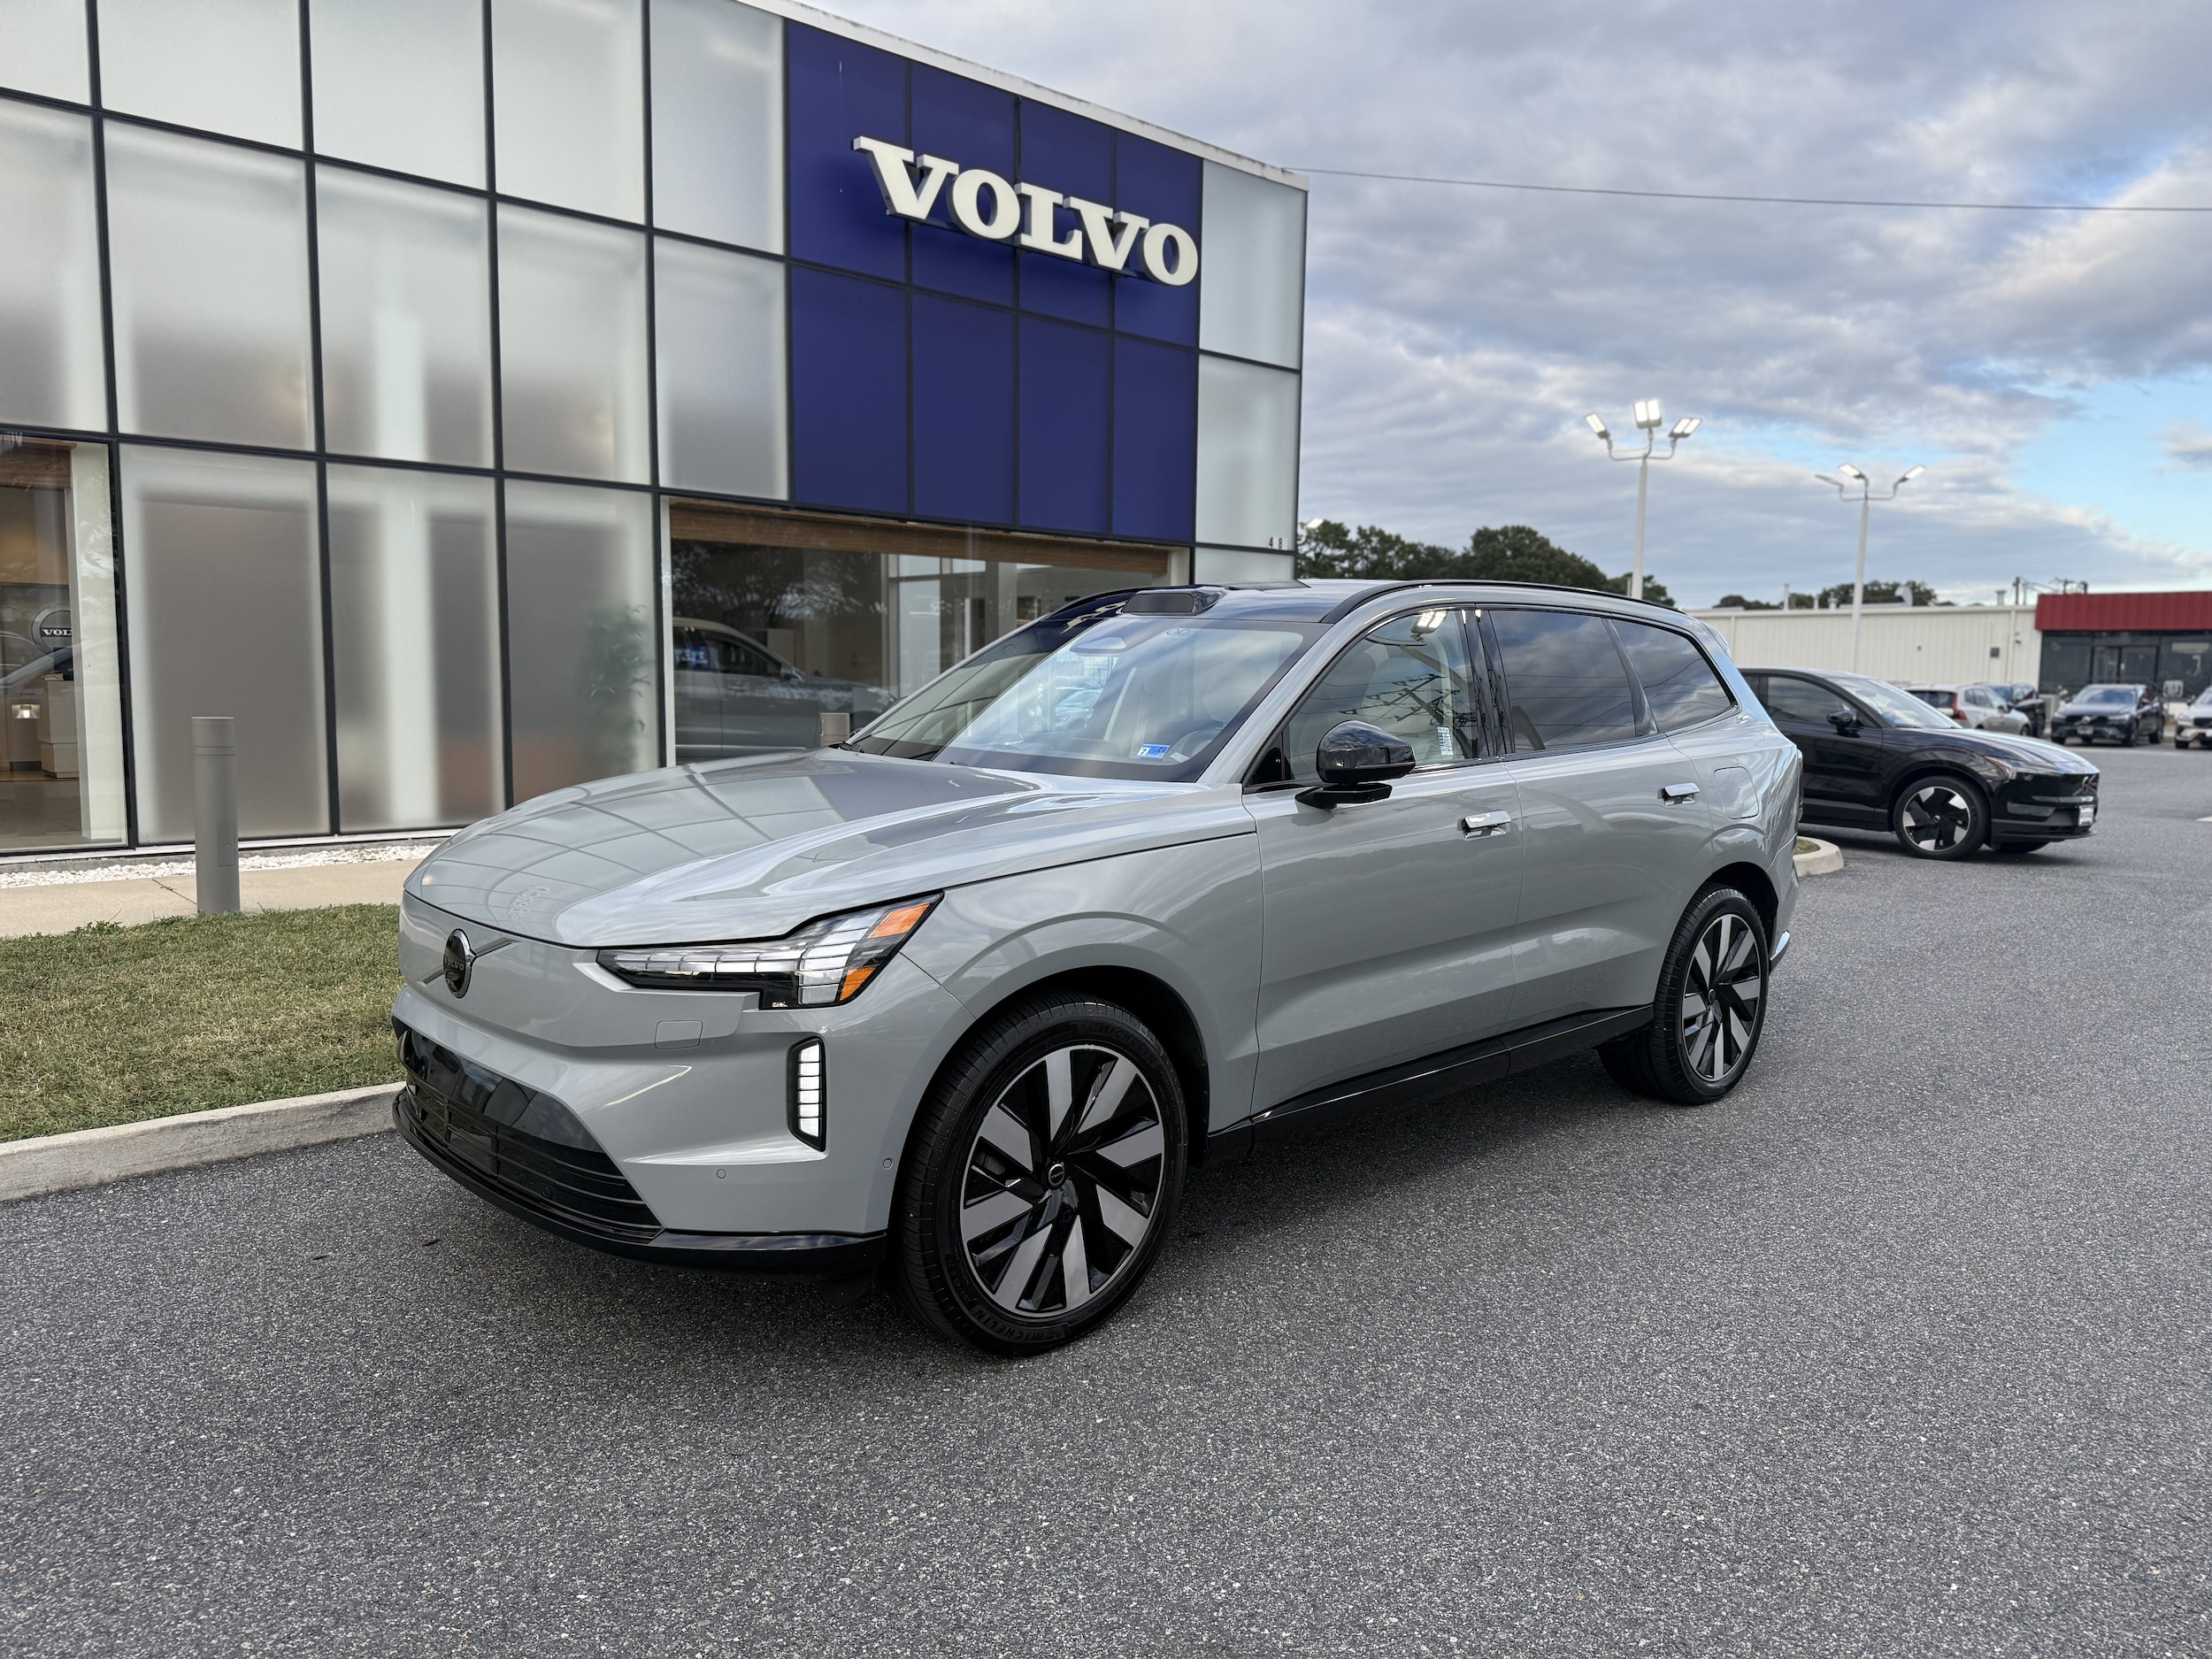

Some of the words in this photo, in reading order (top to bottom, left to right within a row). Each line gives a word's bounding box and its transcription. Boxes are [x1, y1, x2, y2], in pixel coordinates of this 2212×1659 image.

[851, 135, 1199, 287] VOLVO
[444, 956, 465, 972] VOLVO
[1096, 1024, 1158, 1067] MICHELIN
[974, 1309, 1045, 1340] MICHELIN
